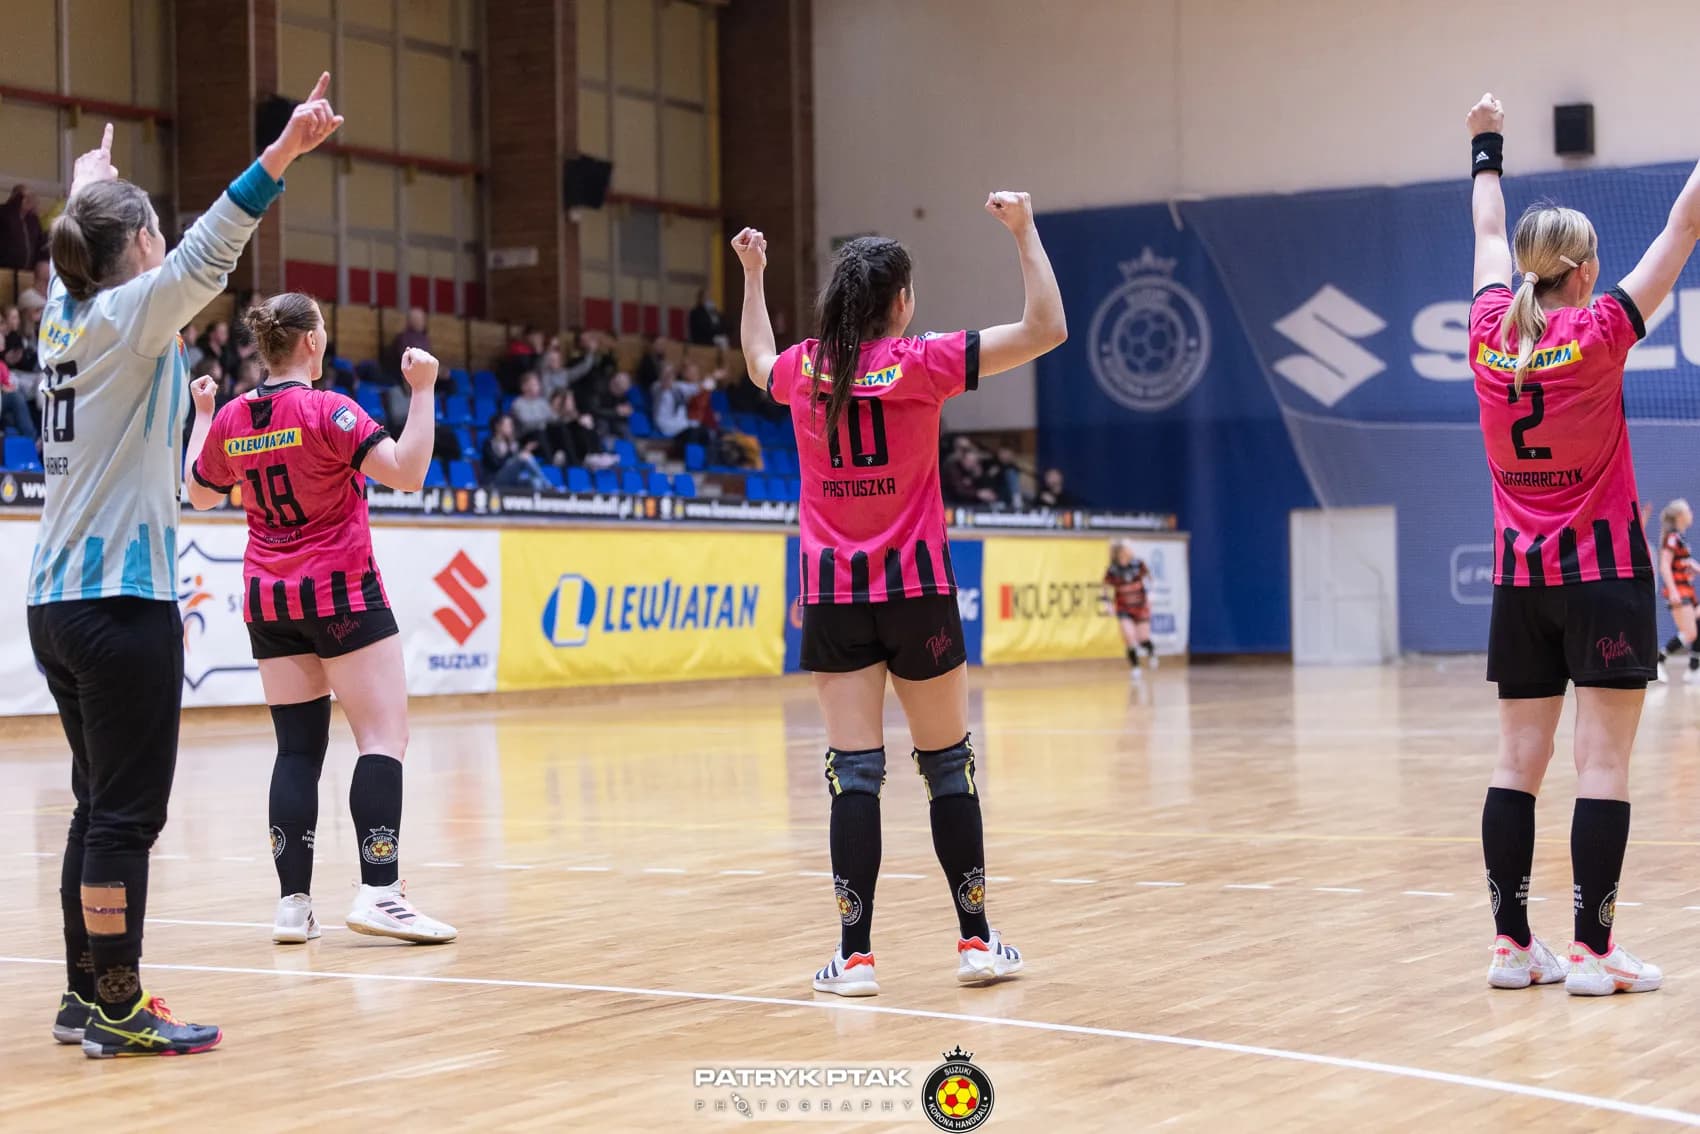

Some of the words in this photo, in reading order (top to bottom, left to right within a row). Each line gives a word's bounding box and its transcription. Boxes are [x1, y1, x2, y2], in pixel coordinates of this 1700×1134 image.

[818, 392, 889, 468] 10
[1507, 383, 1552, 459] 2
[246, 464, 309, 528] 18
[823, 478, 896, 497] PASTUSZKA
[602, 578, 760, 632] LEWIATAN
[1012, 583, 1112, 617] KOLPORTE
[428, 654, 488, 670] SUZUKI
